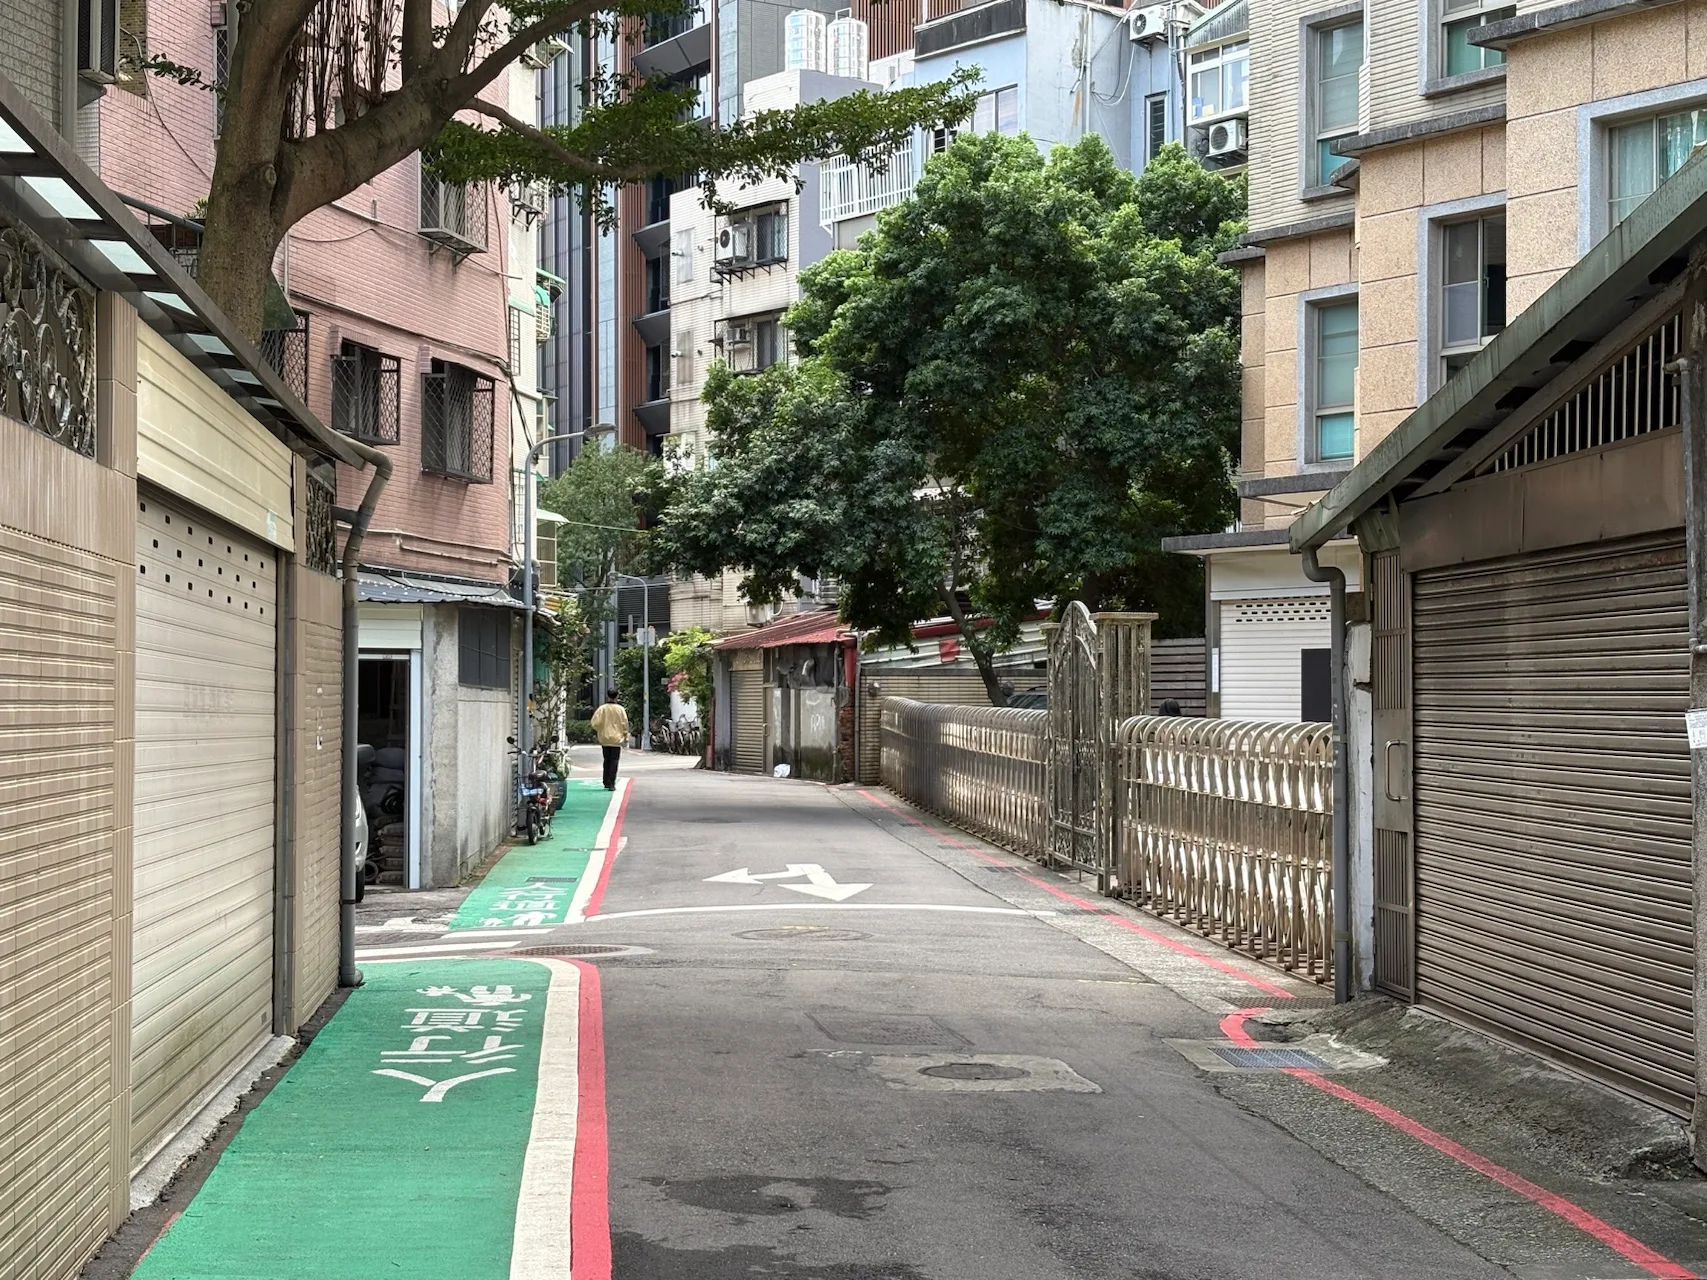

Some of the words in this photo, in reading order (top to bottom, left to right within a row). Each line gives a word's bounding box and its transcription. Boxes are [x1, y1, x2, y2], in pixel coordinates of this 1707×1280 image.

[489, 882, 568, 911] 人行道
[371, 1008, 529, 1102] 人行道
